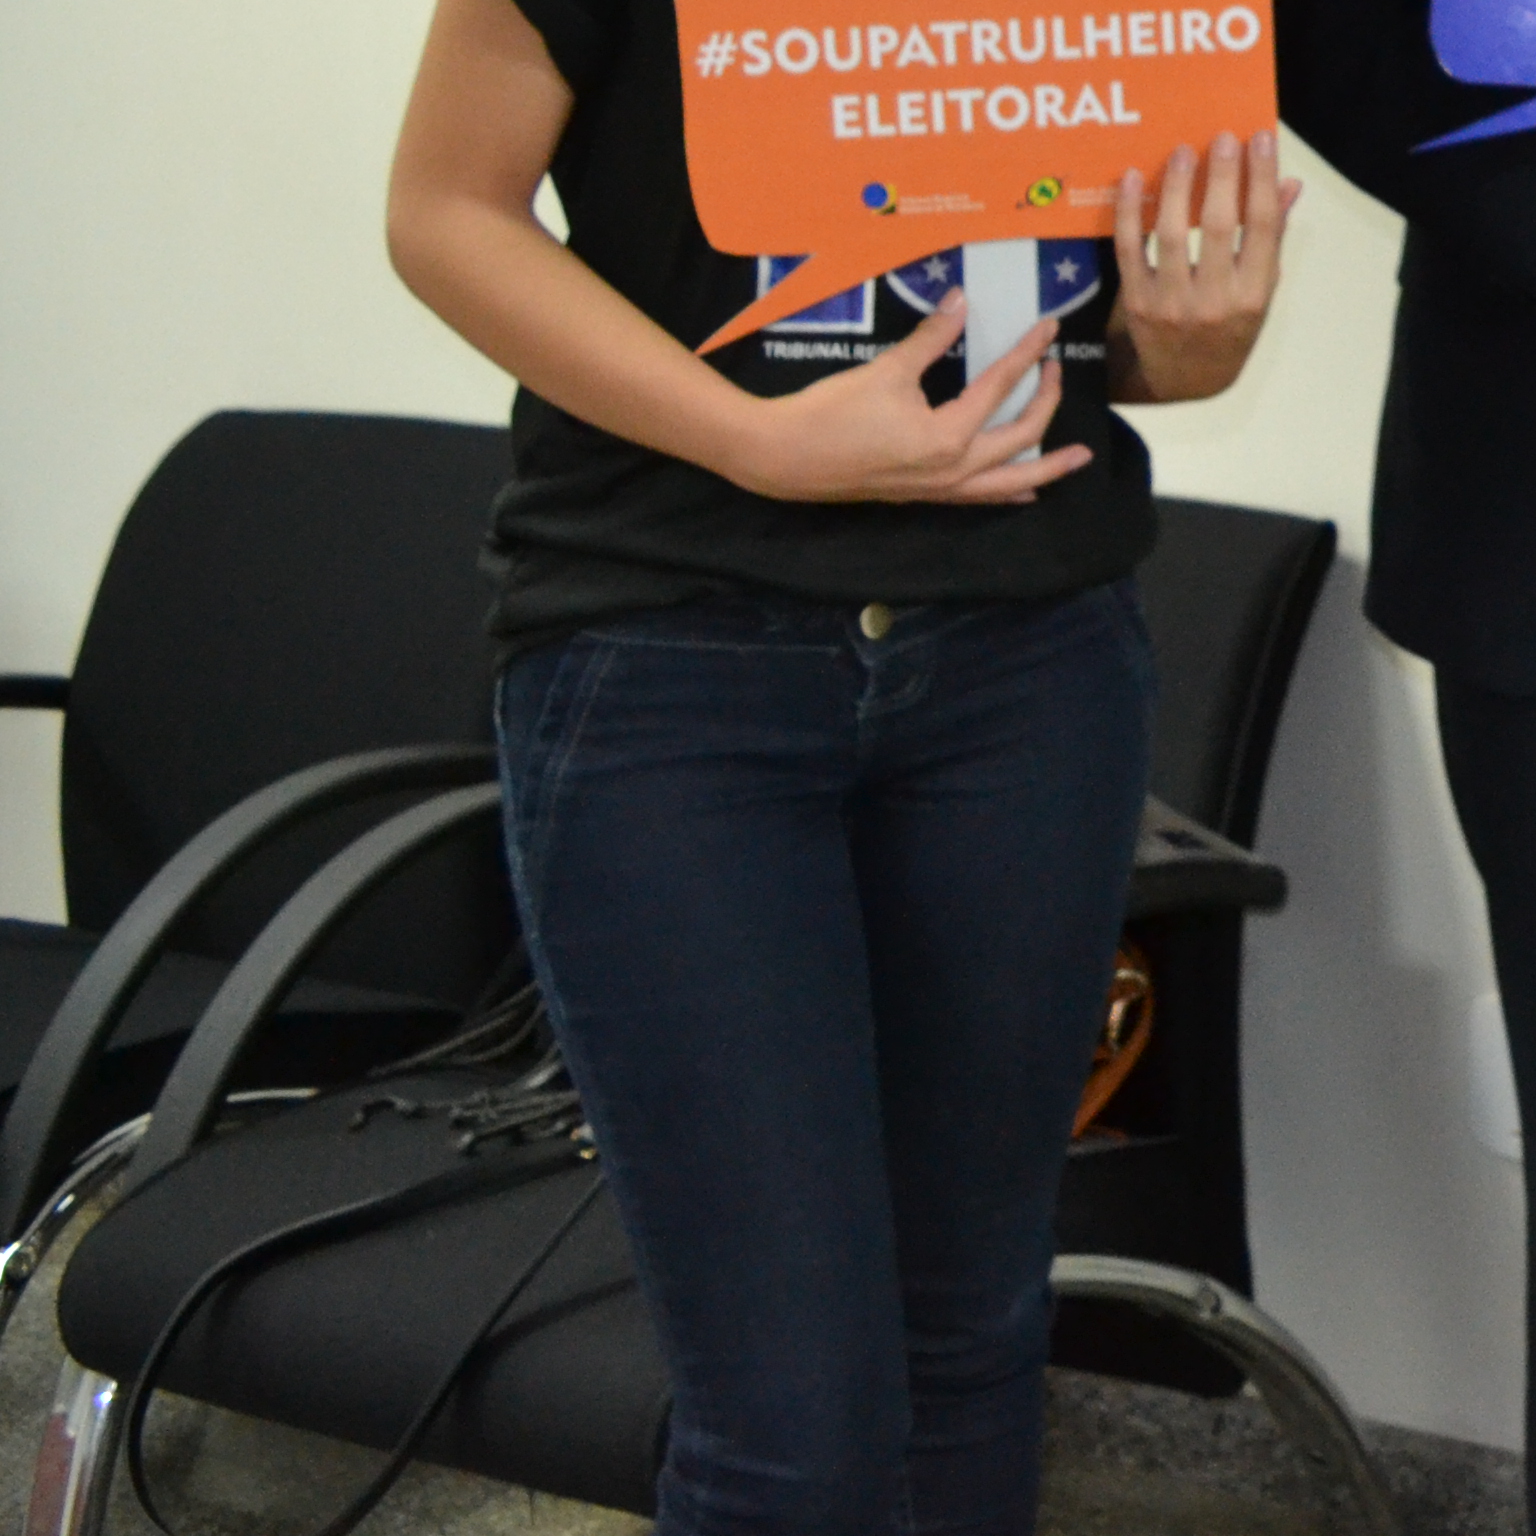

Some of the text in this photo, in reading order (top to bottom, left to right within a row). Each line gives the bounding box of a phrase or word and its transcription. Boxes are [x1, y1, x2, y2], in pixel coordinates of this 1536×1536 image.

[695, 5, 1261, 78] #SOUPATRULHEIRO
[831, 81, 1141, 140] ELEITORAL
[763, 340, 851, 361] TRIBUNAL
